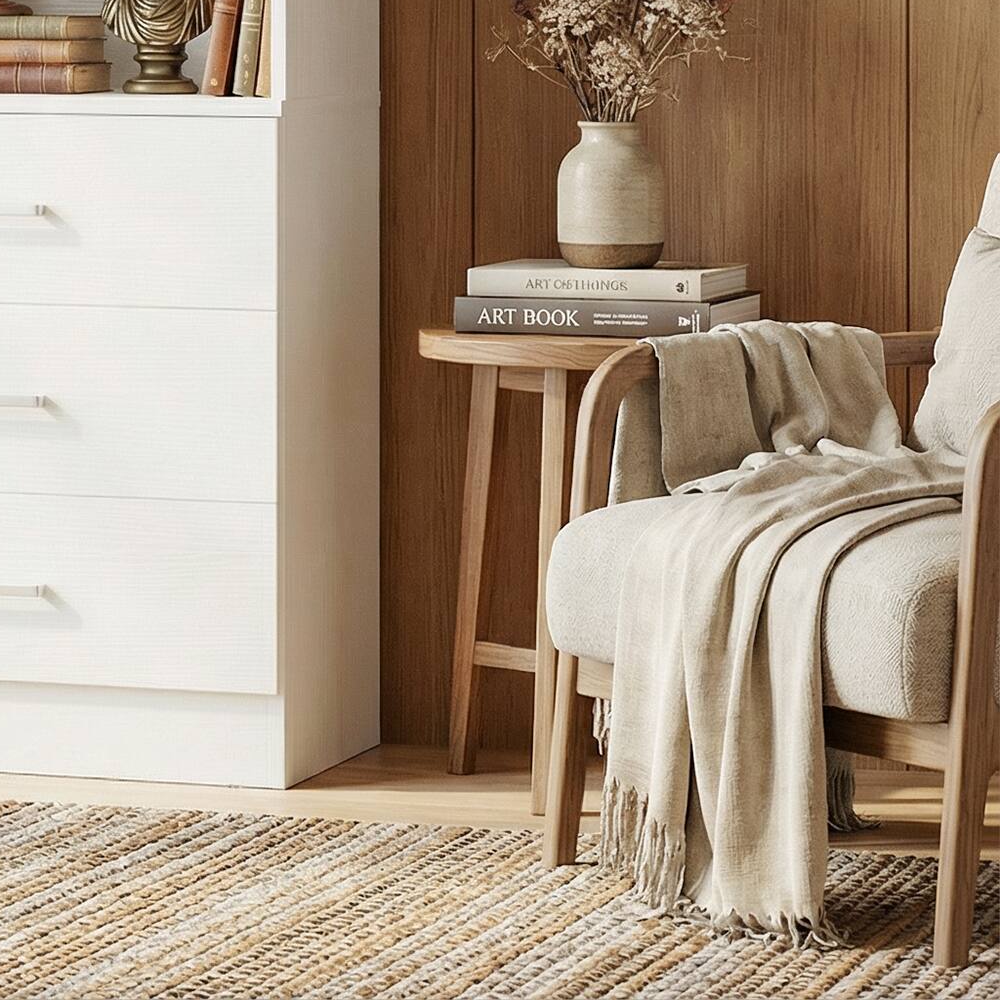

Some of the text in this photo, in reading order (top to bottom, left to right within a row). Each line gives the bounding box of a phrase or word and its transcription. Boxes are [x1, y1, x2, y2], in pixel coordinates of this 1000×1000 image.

[525, 279, 551, 290] ART
[477, 307, 580, 327] ART BOOK
